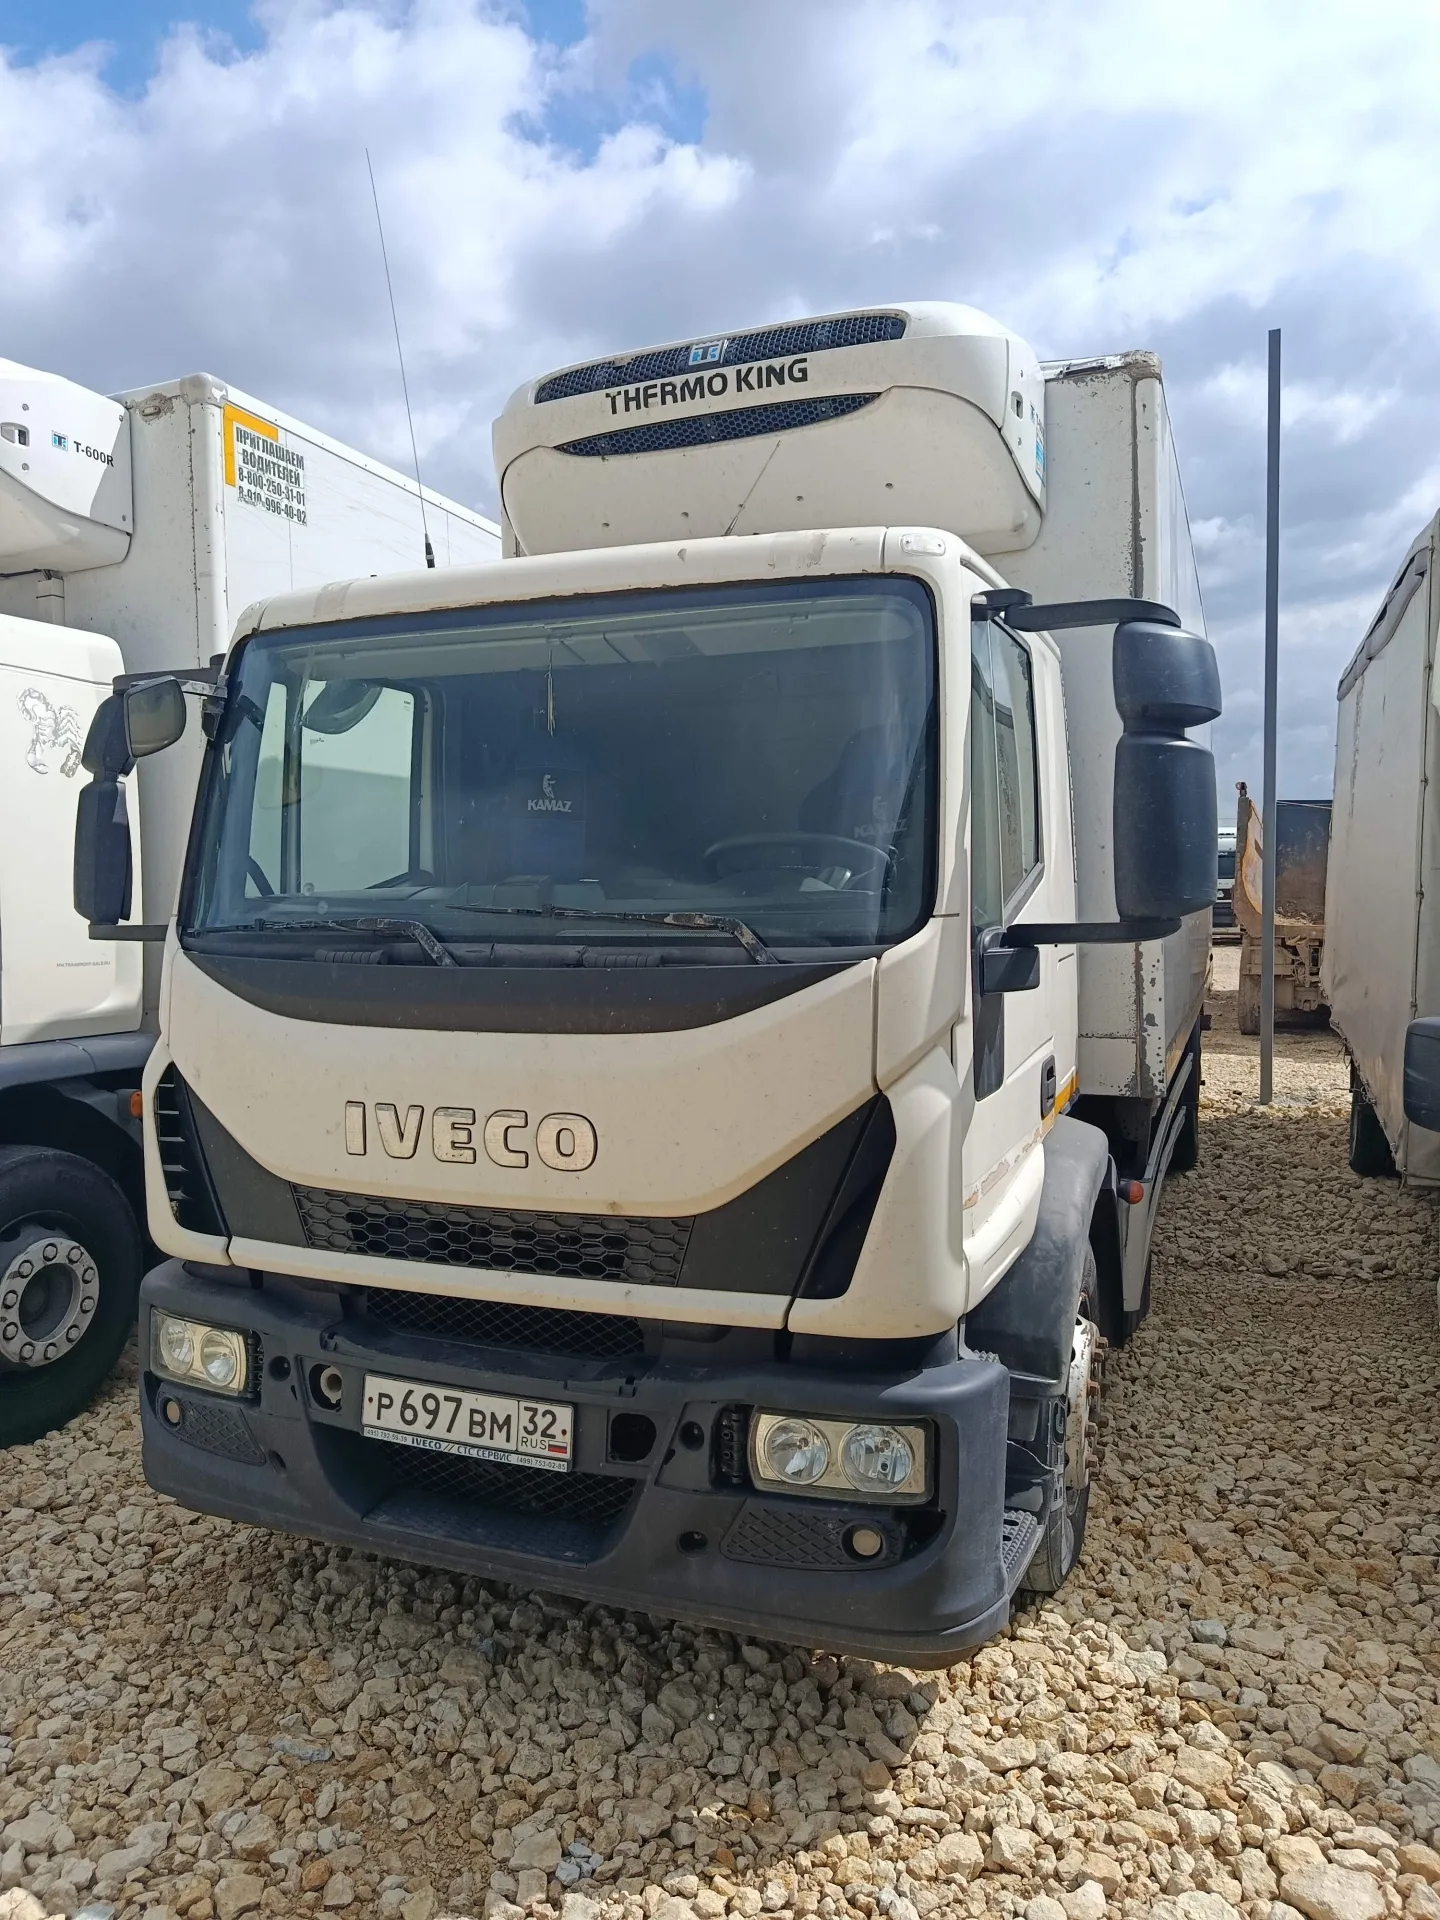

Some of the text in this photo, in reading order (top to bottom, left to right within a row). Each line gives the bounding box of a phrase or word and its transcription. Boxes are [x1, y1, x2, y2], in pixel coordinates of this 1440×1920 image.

[605, 358, 809, 415] THERMO KING
[73, 440, 115, 468] T-600R
[236, 426, 304, 471] ПРИГЛАШАЕМ
[242, 448, 301, 488] ВОДИТЕЛЕЙ
[238, 466, 306, 507] 8-800-250-31-01
[238, 485, 307, 525] 8-910996-40-02
[527, 799, 572, 813] KAMAZ
[344, 1100, 599, 1173] IVECO
[520, 1436, 548, 1450] RUS
[522, 1406, 557, 1440] 32
[411, 1436, 442, 1450] IVECO
[456, 1445, 476, 1456] СТС
[476, 1448, 512, 1463] СЕРВИС
